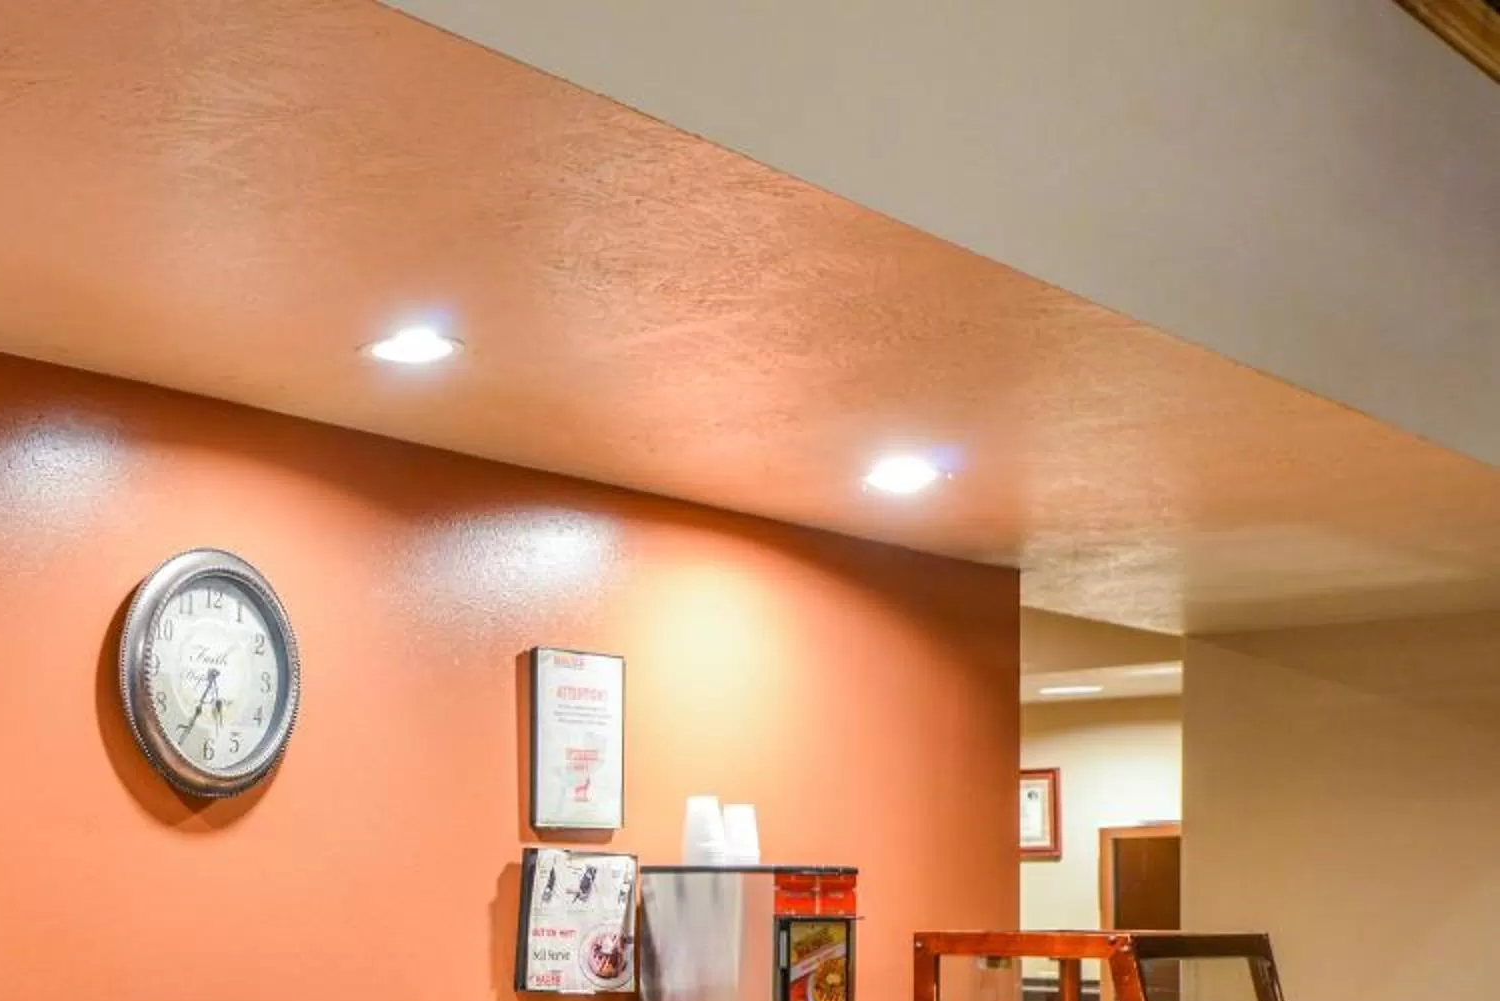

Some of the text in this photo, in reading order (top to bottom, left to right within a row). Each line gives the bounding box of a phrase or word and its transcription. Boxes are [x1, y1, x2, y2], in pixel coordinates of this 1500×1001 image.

[179, 593, 194, 615] 11
[205, 586, 224, 609] 12
[234, 600, 244, 622] 1
[156, 619, 173, 641] 10
[254, 633, 266, 656] 2
[260, 672, 272, 693] 3
[156, 692, 167, 714] 8
[253, 707, 263, 728] 4
[202, 738, 215, 761] 6
[229, 731, 241, 754] 5
